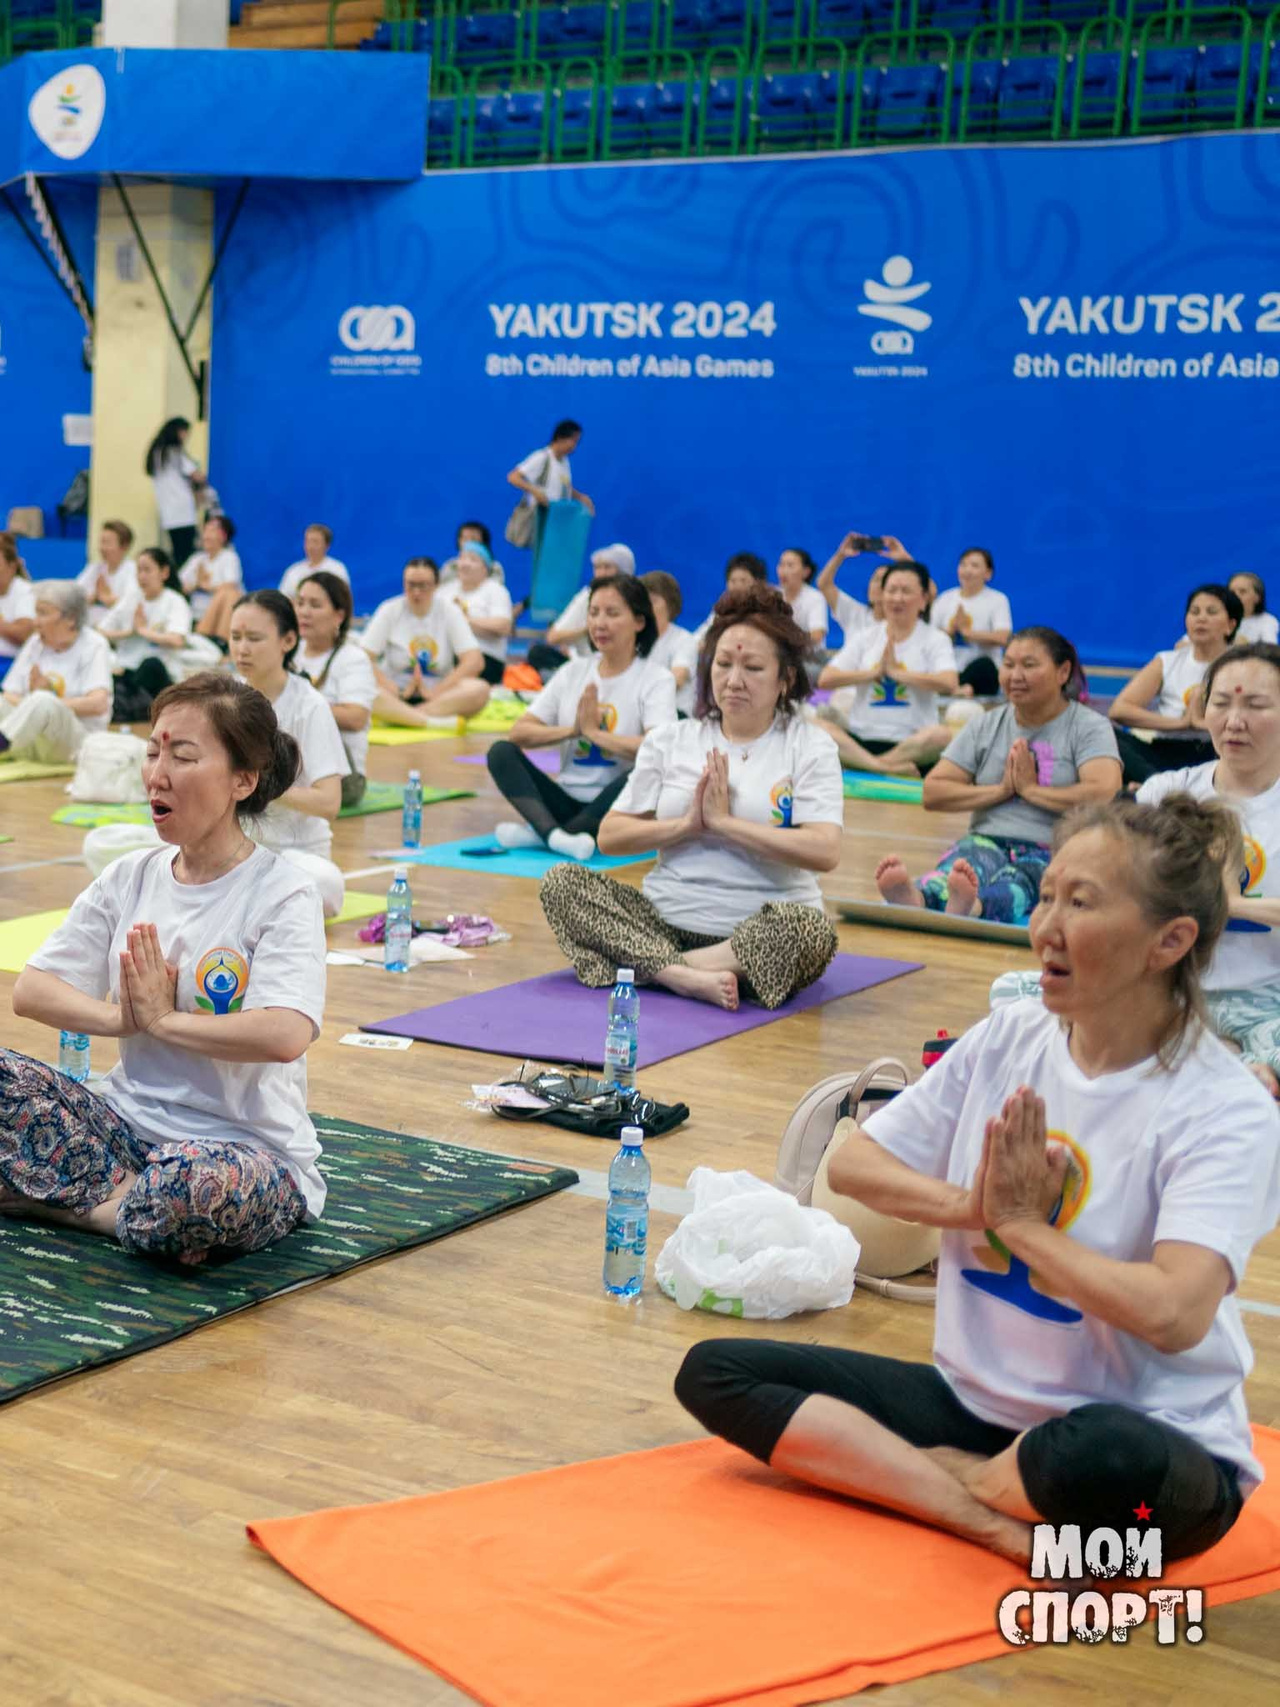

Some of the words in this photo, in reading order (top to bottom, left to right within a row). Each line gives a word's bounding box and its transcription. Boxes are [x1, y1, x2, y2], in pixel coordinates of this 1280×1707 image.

[488, 303, 664, 339] YAKUTSK
[670, 301, 778, 338] 2024
[1018, 293, 1245, 336] YAKUTSK
[485, 354, 524, 378] 8th
[526, 354, 614, 378] Children
[616, 354, 642, 378] of
[643, 354, 692, 378] Asia
[695, 354, 775, 378] Games
[1013, 354, 1060, 379] 8th
[1065, 353, 1177, 379] Children
[1184, 353, 1215, 377] of
[1216, 353, 1280, 378] Asia
